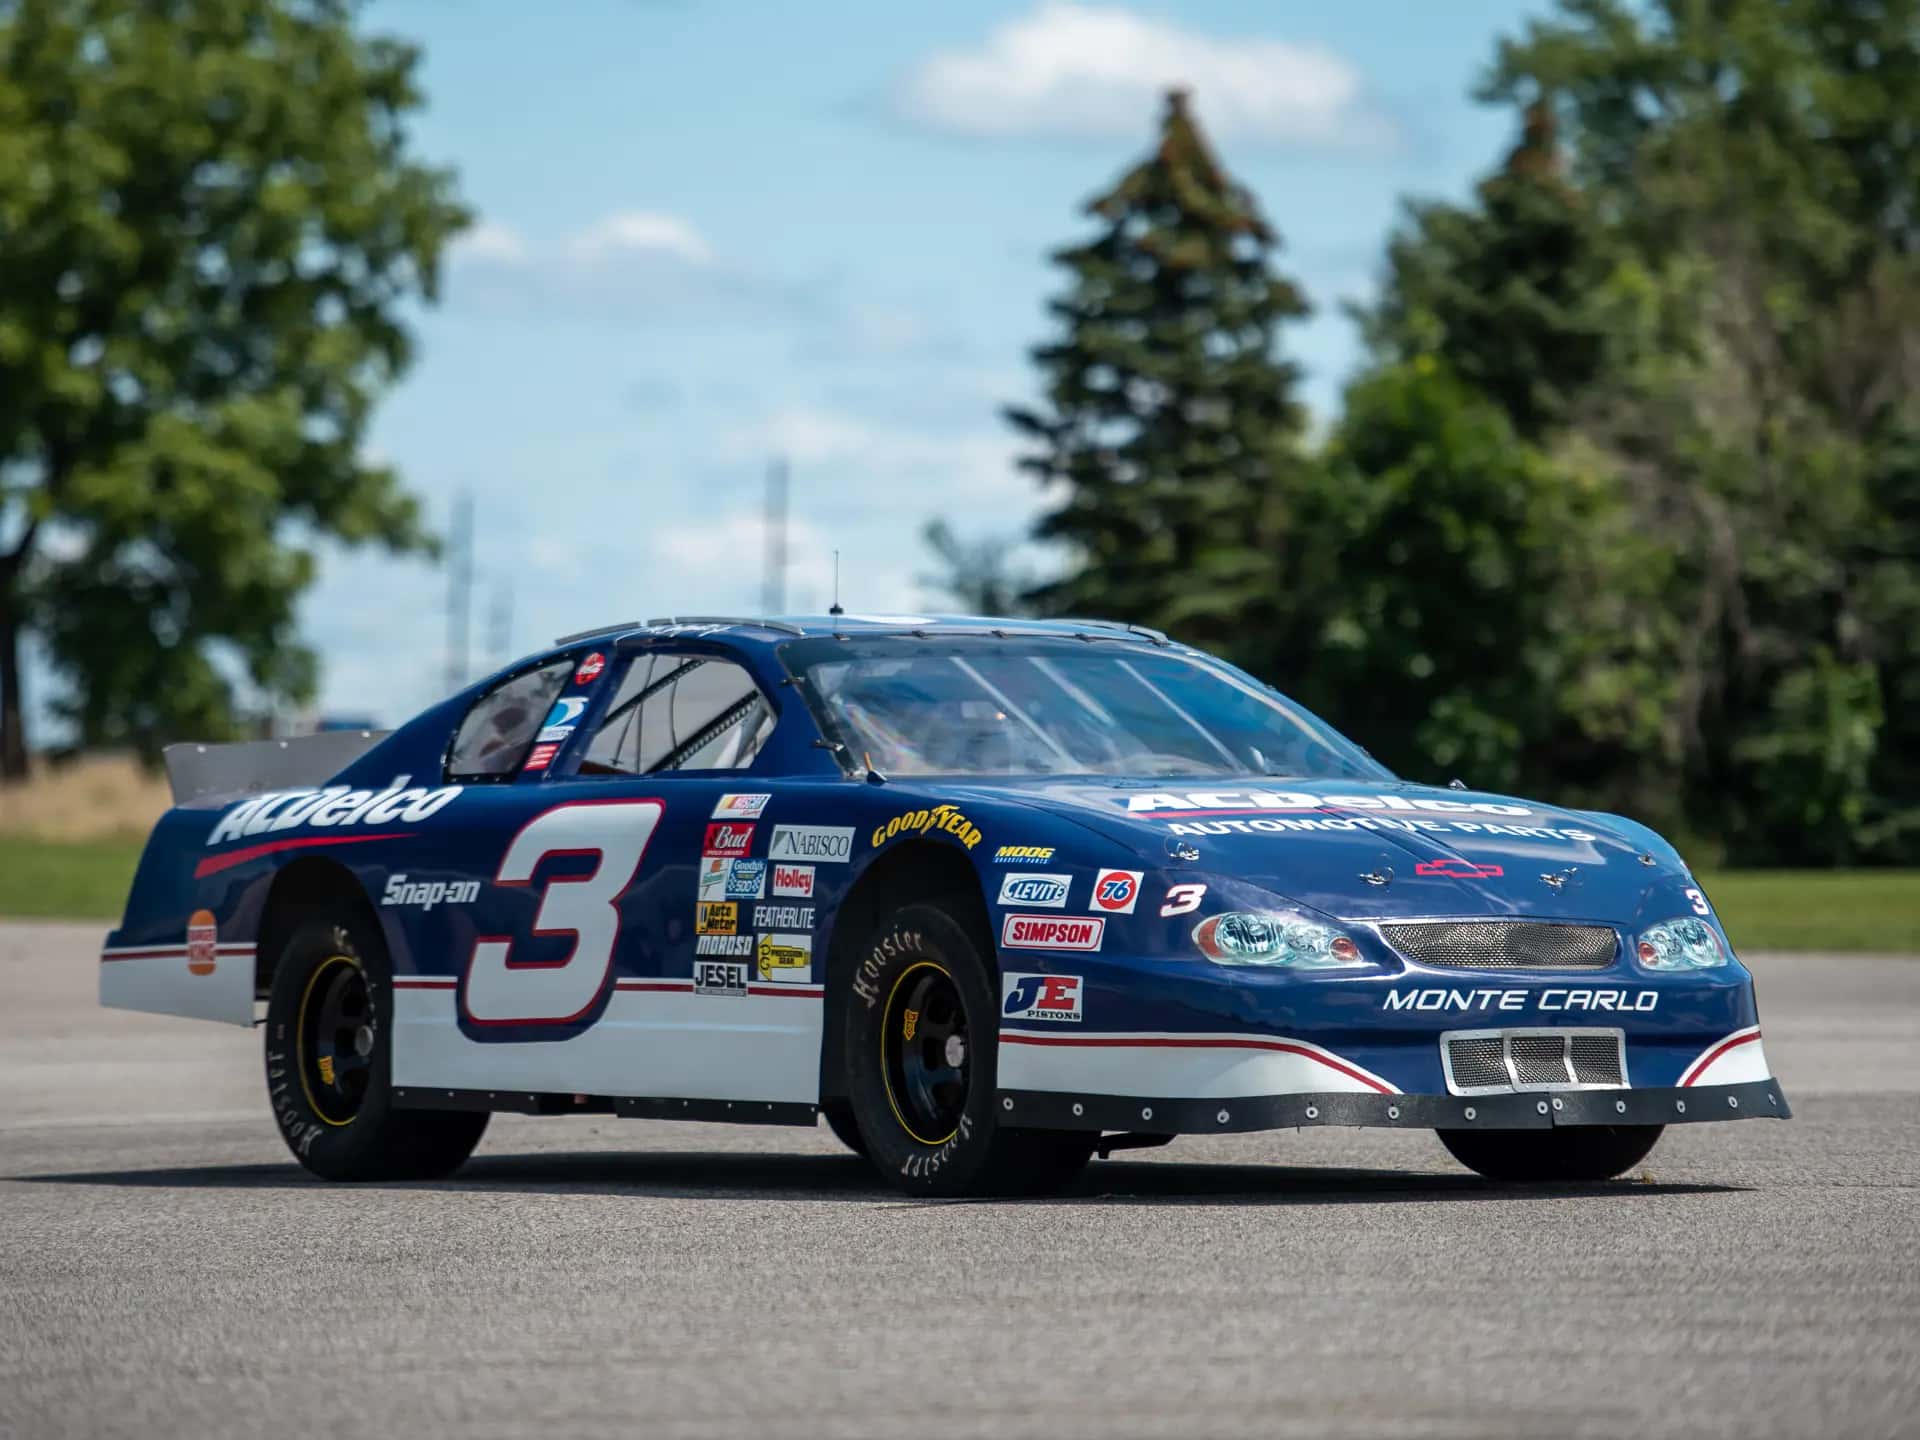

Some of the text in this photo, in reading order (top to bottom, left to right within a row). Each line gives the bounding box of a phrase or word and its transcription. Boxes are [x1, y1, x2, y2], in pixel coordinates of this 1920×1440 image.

[206, 775, 464, 847] ACDelco
[1127, 792, 1532, 818] ACDelco
[715, 826, 754, 848] Bud
[1166, 817, 1598, 842] AUTOMOTIVE PARTS
[785, 831, 850, 857] NABISCO
[995, 846, 1057, 858] MOOG
[382, 874, 482, 912] Snap-on
[775, 868, 812, 894] Holley
[1004, 878, 1066, 900] CLEVITE
[1100, 880, 1131, 900] 76
[465, 800, 662, 1023] 3
[709, 904, 732, 917] Auto
[1159, 883, 1208, 918] 3
[1686, 888, 1710, 915] 3
[753, 906, 815, 929] FEATHERLITE
[1012, 921, 1094, 944] SIMPSON
[696, 936, 753, 955] MOROSO
[695, 965, 746, 989] JESEL
[1004, 976, 1079, 1014] JE
[1383, 989, 1660, 1013] MONTE CARLO
[1027, 1010, 1081, 1021] PISTONS
